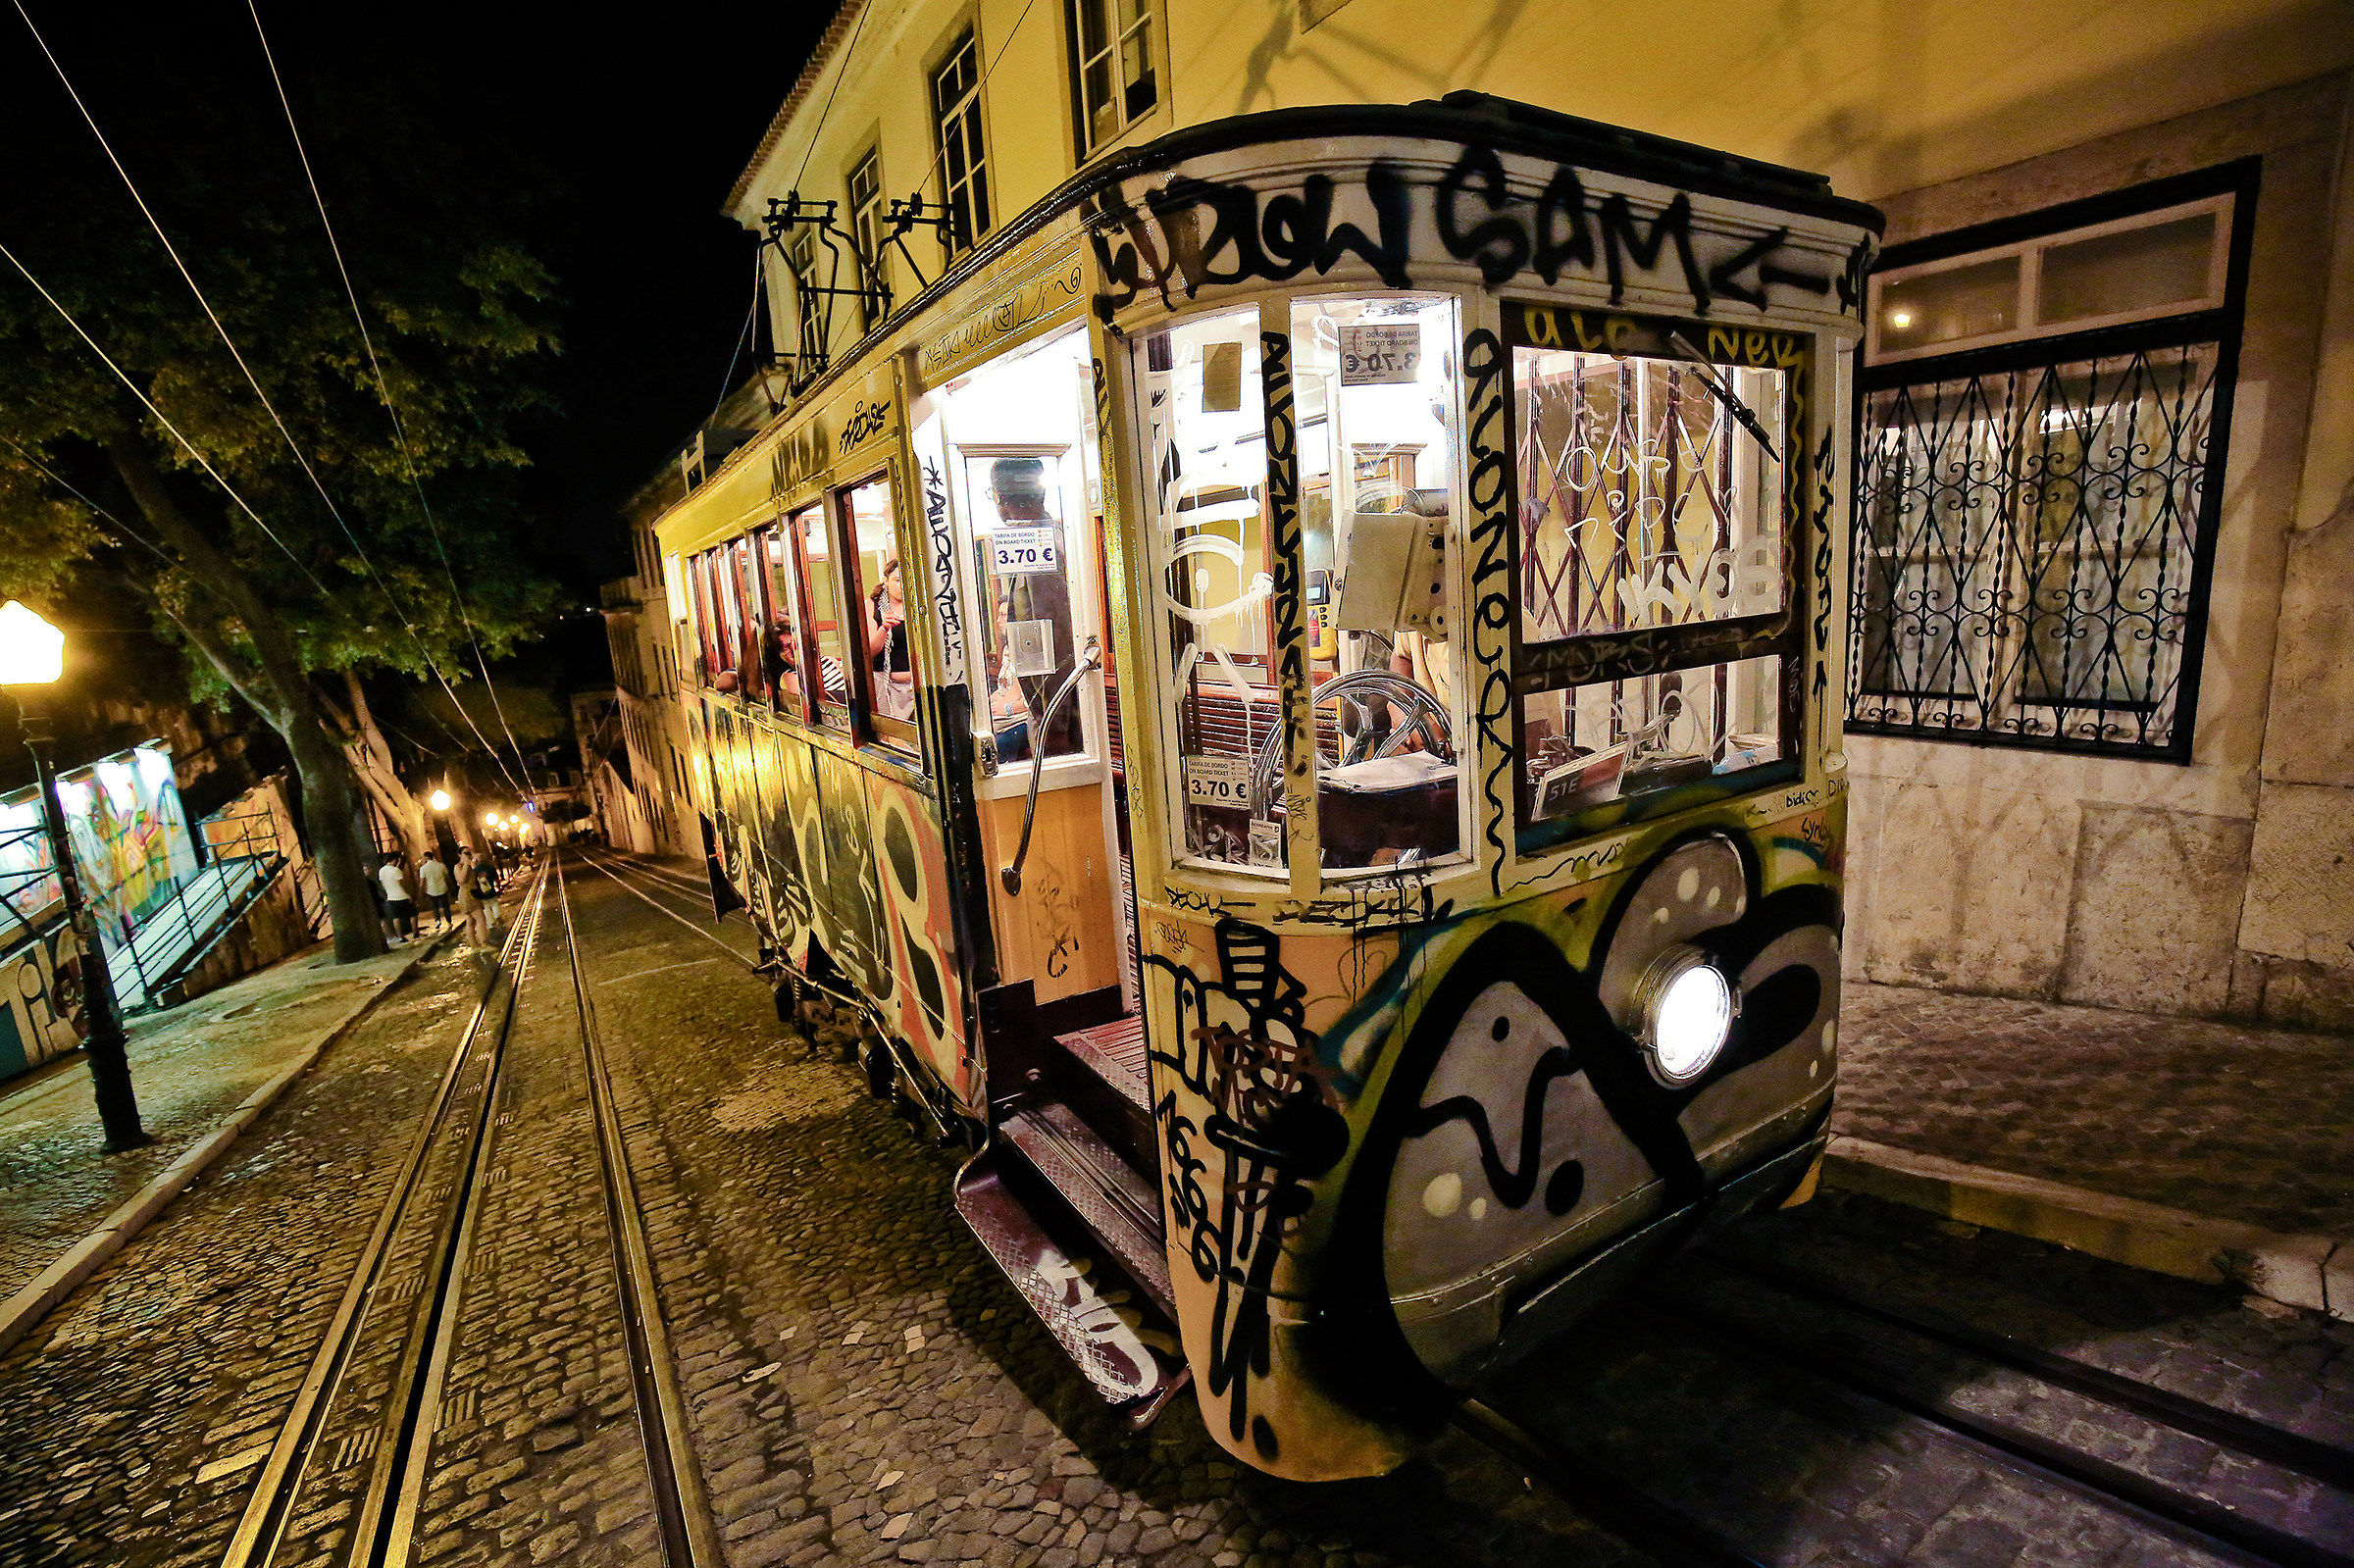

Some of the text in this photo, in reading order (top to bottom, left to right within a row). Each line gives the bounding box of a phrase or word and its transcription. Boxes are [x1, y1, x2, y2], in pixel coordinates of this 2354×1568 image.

[998, 547, 1053, 564] 3.70 €
[1192, 779, 1248, 799] 3.70 €
